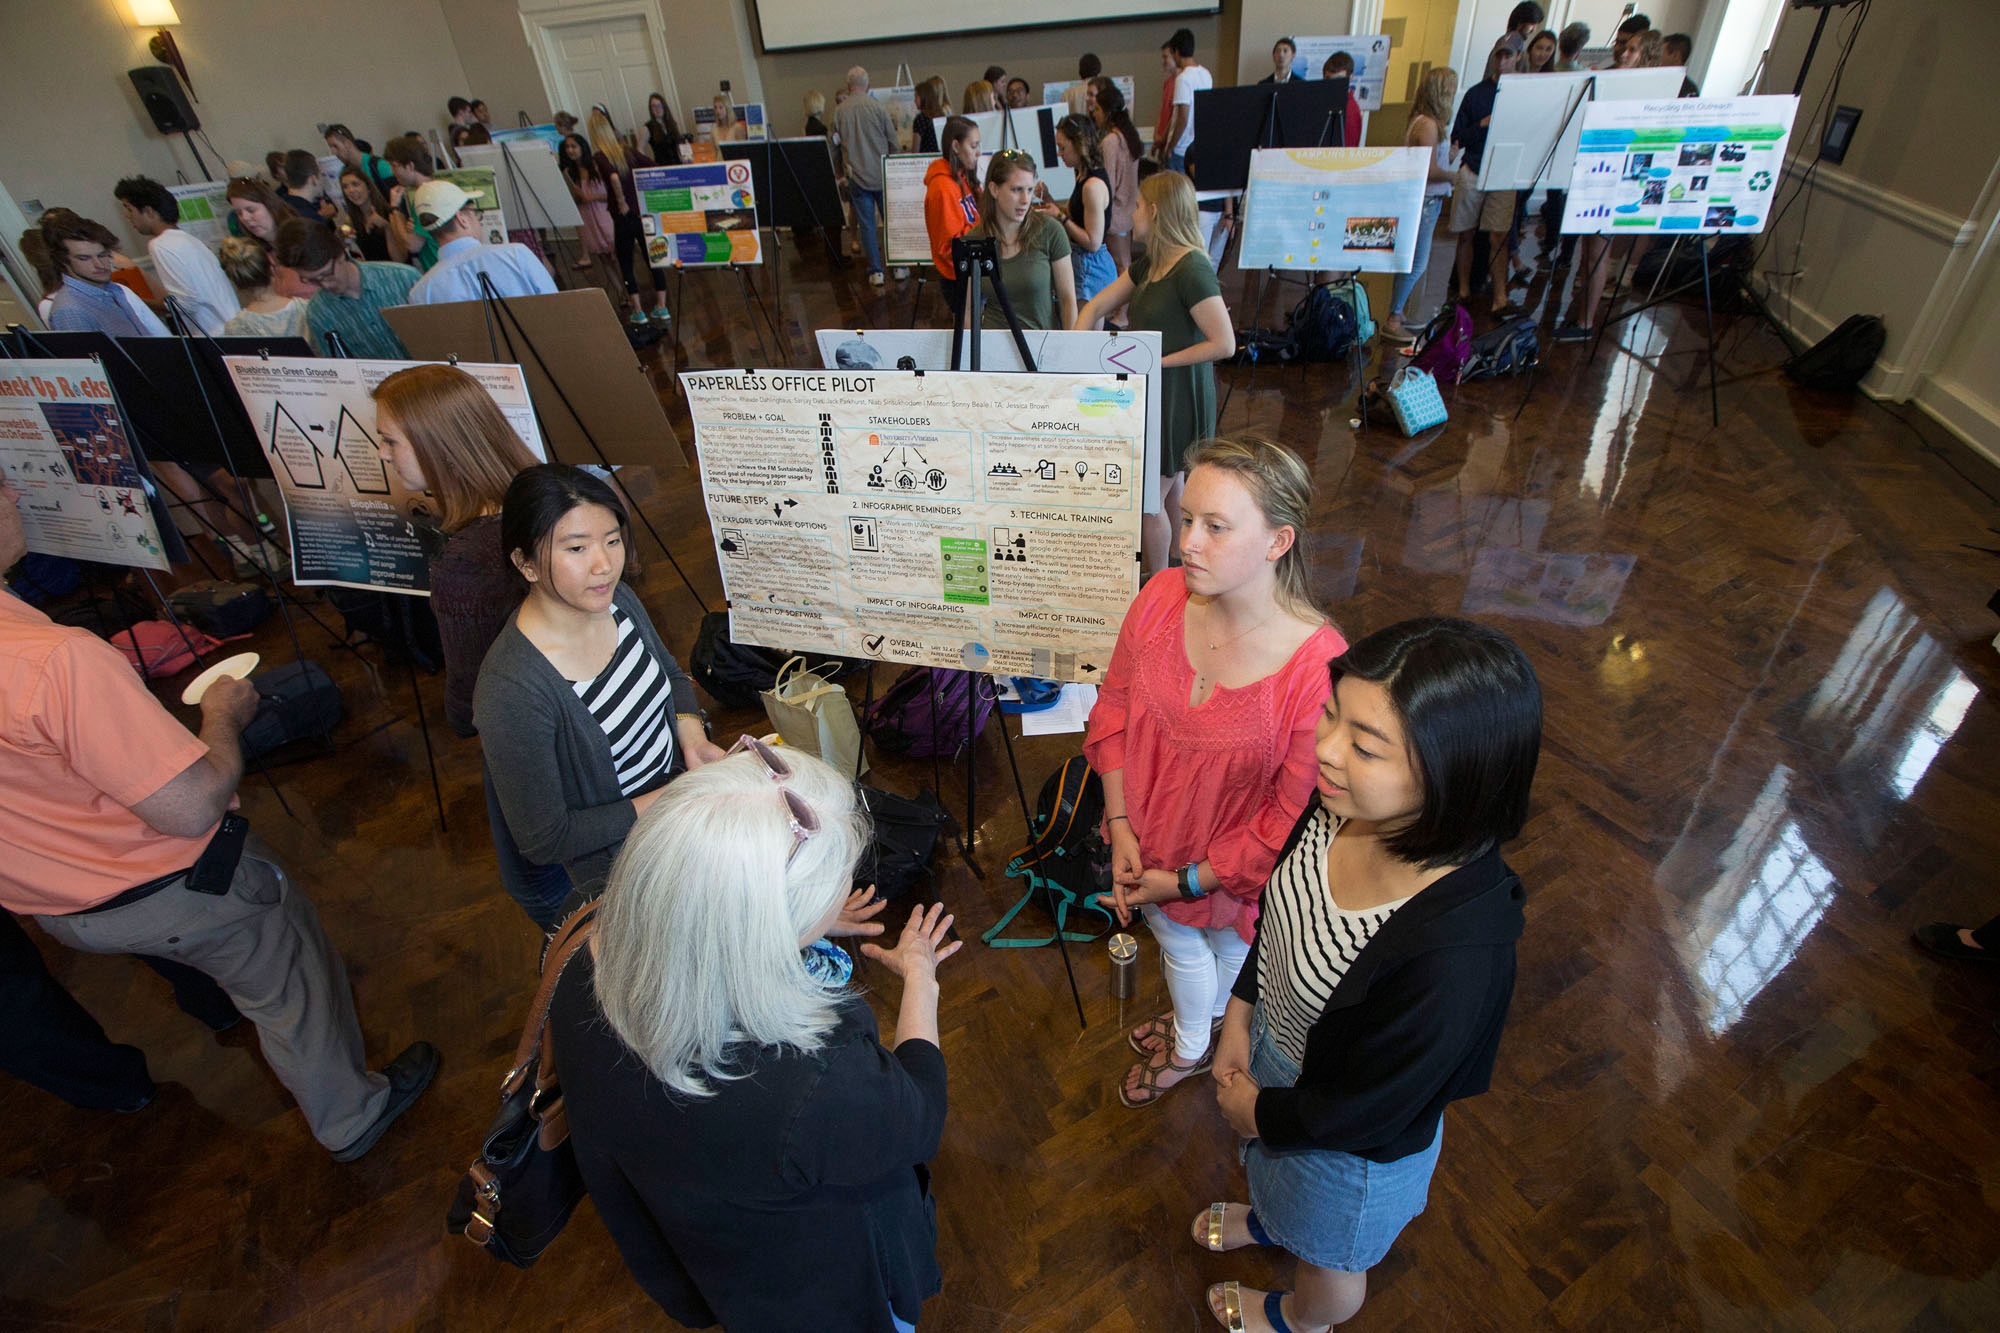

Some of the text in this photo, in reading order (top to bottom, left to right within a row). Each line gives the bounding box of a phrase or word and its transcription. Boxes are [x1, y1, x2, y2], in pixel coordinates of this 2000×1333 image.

[1296, 149, 1384, 160] SAMPLING SAVIOR
[235, 365, 270, 374] Bluebirds
[283, 367, 304, 376] Green
[306, 368, 338, 377] Grounds
[688, 376, 876, 392] PAPERLESS OFFICE PILOT
[723, 412, 786, 422] PROBLEM GOAL
[869, 417, 930, 426] STAKEHOLDERS
[1032, 422, 1080, 431] APPROACH
[709, 494, 768, 505] FUTURE STEPS
[862, 502, 961, 515] INFOGRAPHIC REMINDERS
[723, 516, 827, 530] EXPLORE SOFTWARE OPTIONS
[1021, 511, 1068, 521] TECHNICAL
[1070, 514, 1113, 524] TRAINING
[1051, 531, 1076, 540] periodic
[1078, 532, 1101, 541] training
[1064, 540, 1097, 548] employees
[998, 579, 1035, 588] Step-by-step
[1085, 585, 1108, 594] pictures
[1078, 592, 1104, 601] detailing
[867, 598, 893, 607] IMPACT
[909, 602, 964, 613] INFOGRAPHICS
[749, 606, 822, 619] IMPACT SOFTWARE
[1019, 612, 1048, 621] IMPACT
[1066, 615, 1105, 626] TRAINING
[1027, 623, 1053, 632] efficiency
[890, 639, 923, 649] OVERALL
[893, 649, 921, 658] IMPACT:
